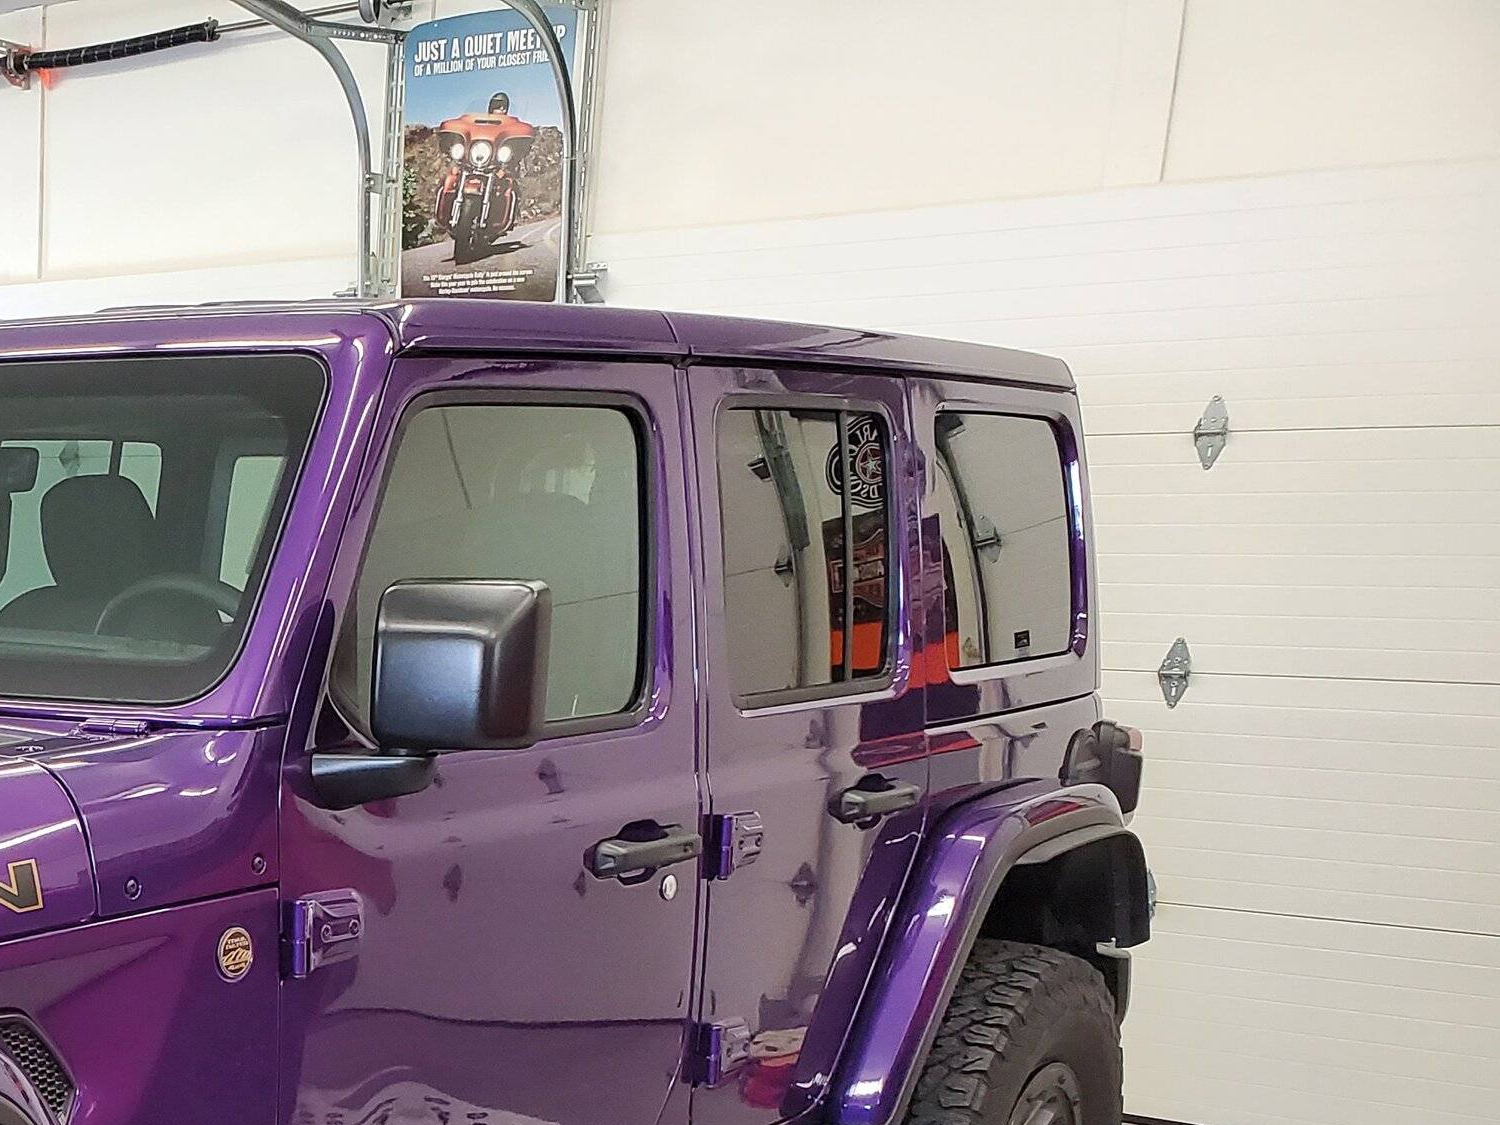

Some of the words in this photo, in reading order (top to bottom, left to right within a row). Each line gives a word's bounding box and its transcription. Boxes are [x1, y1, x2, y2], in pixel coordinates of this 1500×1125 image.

[414, 38, 447, 63] JUST
[451, 37, 460, 58] A
[464, 32, 503, 57] QUIET
[414, 64, 423, 76] OF
[425, 63, 431, 75] A
[433, 59, 463, 74] MILLION
[465, 58, 475, 71] OF
[476, 56, 496, 70] YOUR
[498, 51, 531, 67] CLOSEST
[532, 50, 550, 63] FRIE
